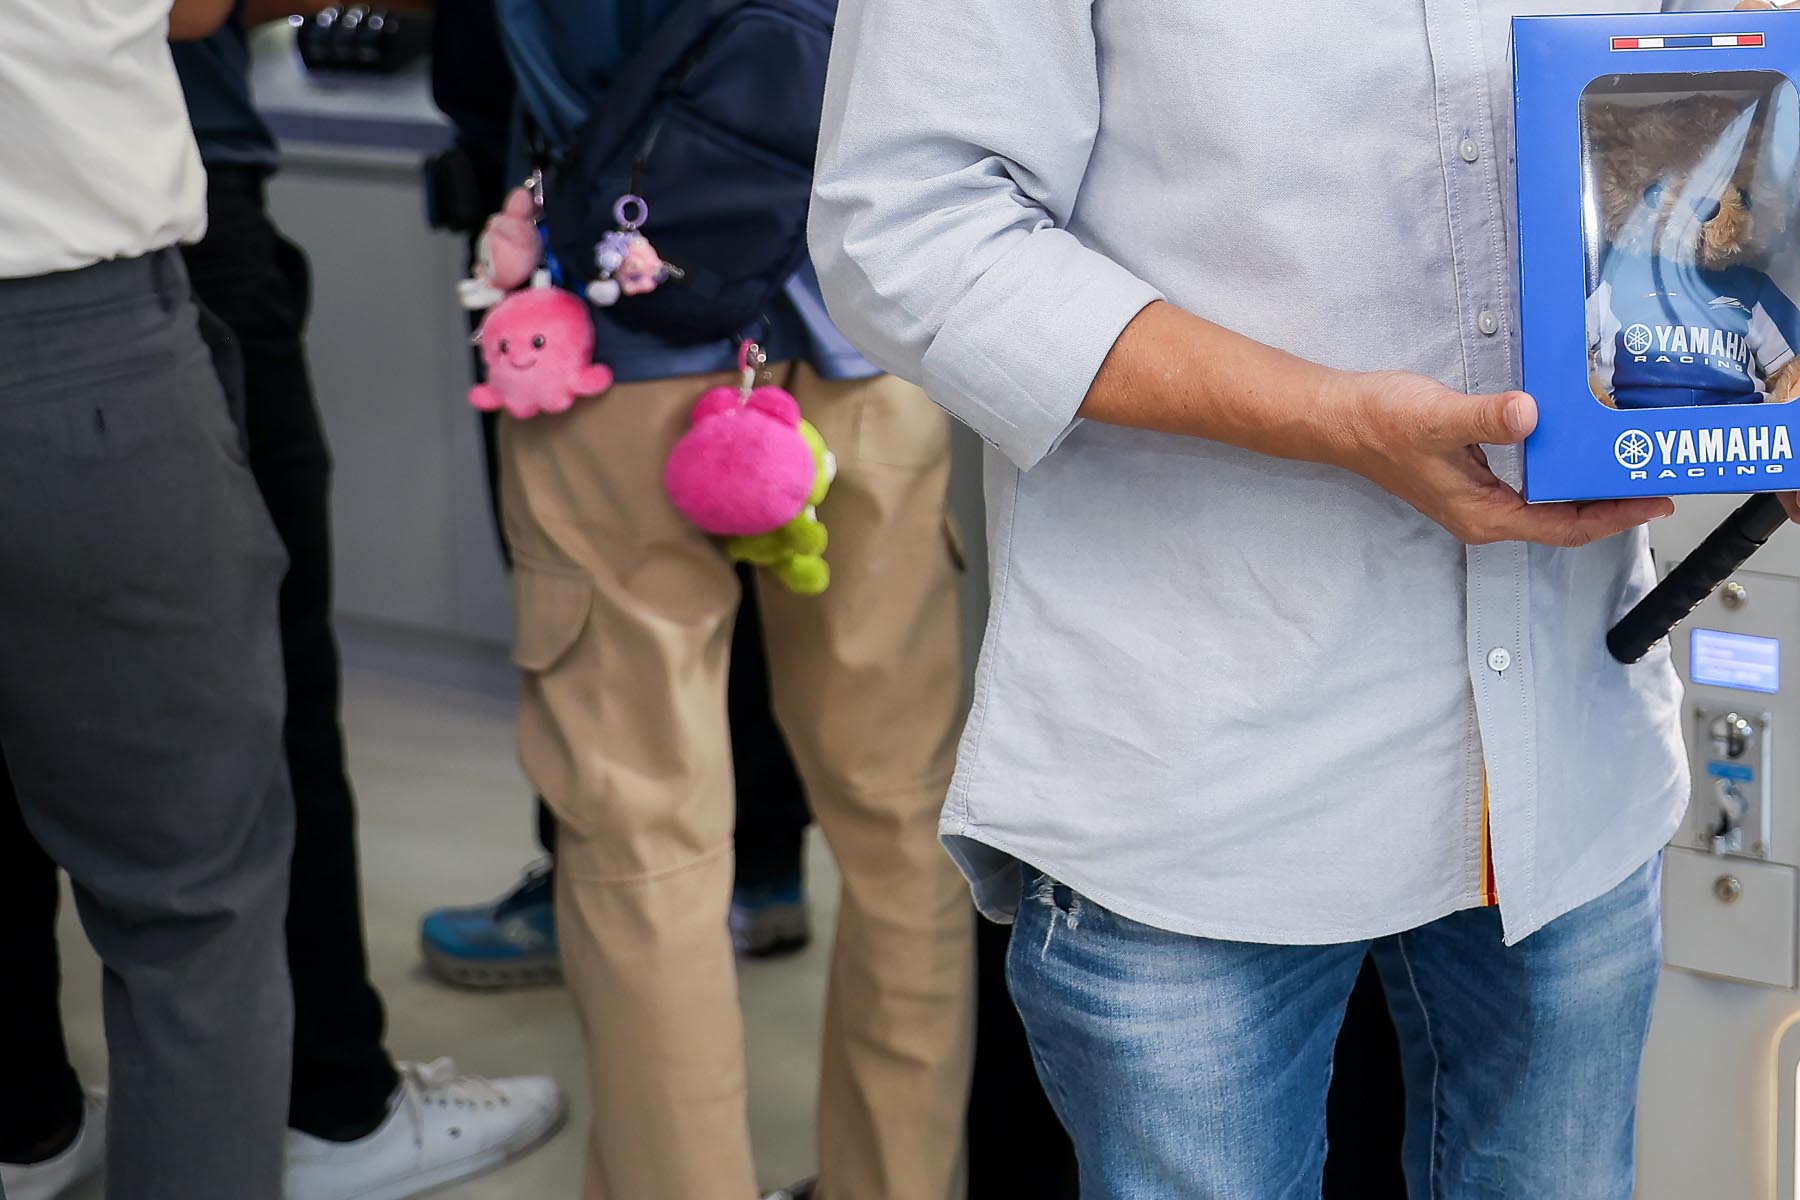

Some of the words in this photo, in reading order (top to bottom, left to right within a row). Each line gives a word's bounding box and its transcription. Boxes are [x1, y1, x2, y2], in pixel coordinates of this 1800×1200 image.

[1655, 325, 1748, 364] YAMAHA
[1634, 356, 1743, 373] RACING
[1654, 425, 1793, 466] YAMAHA
[1630, 464, 1784, 481] RACING
